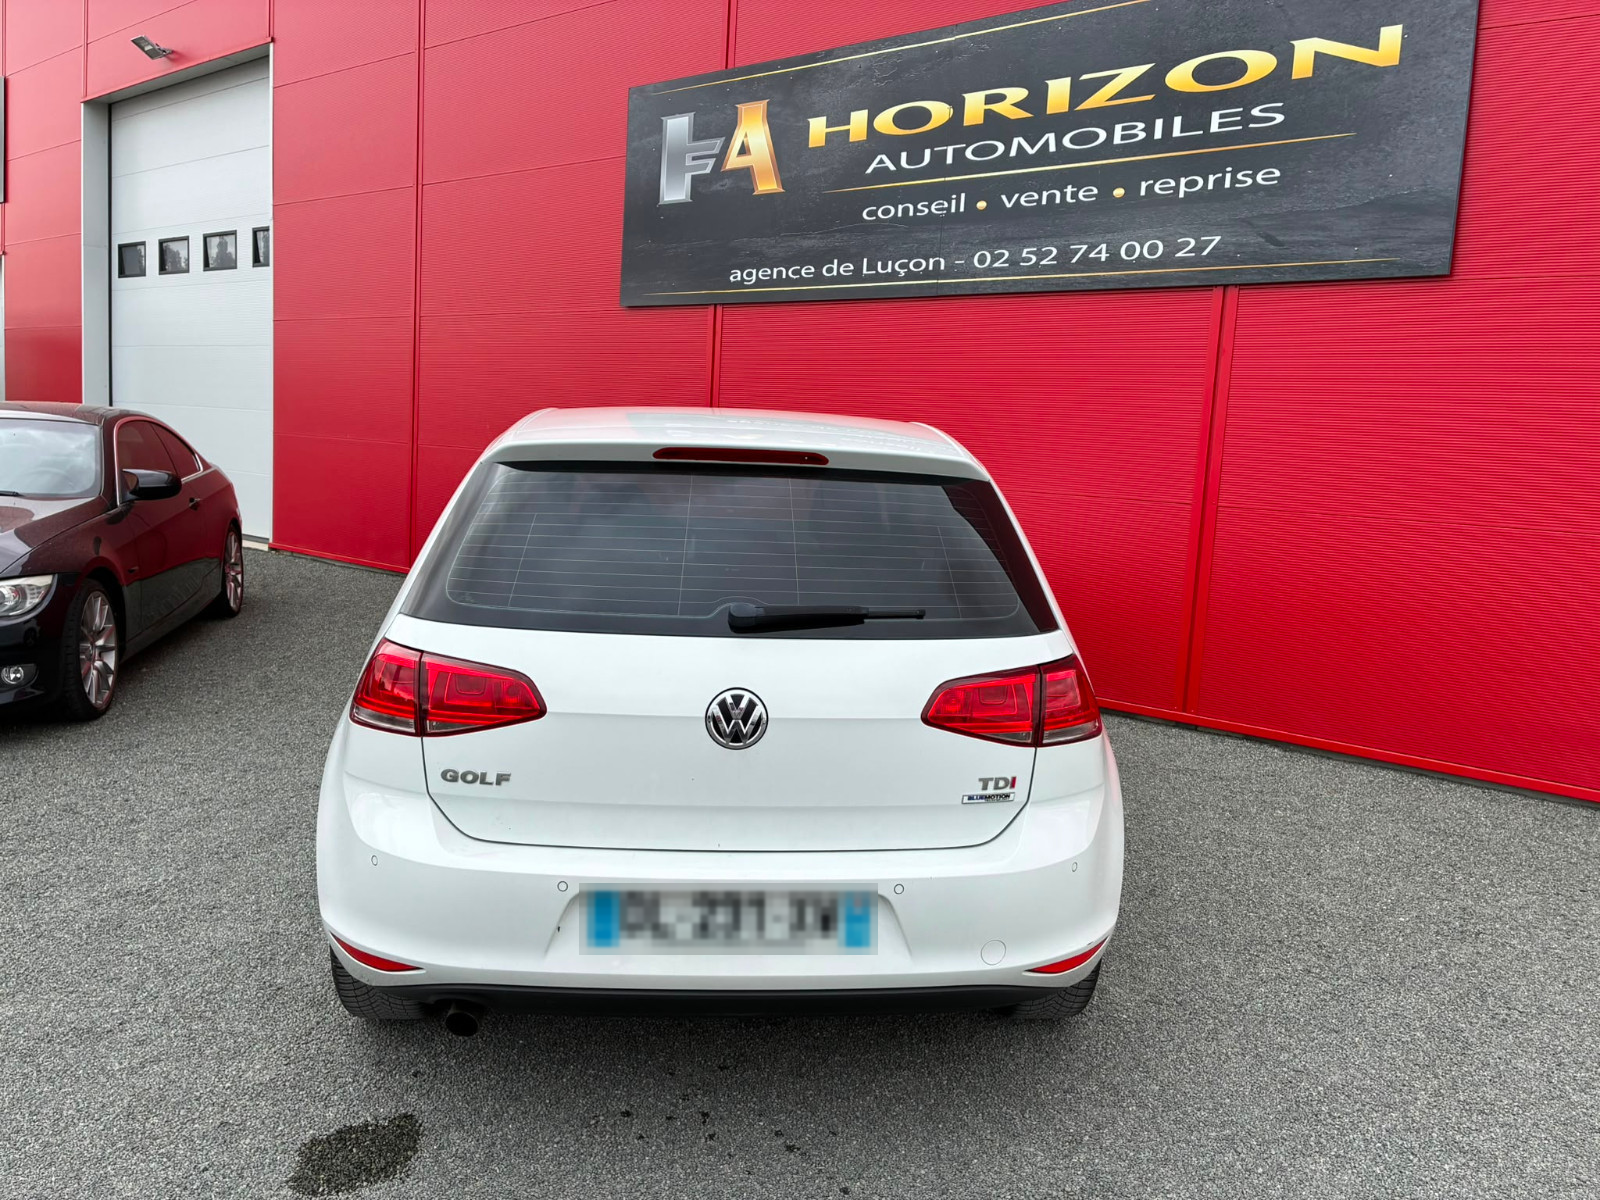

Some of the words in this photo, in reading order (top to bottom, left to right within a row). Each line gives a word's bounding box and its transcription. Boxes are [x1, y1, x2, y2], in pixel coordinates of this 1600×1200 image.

[807, 24, 1403, 148] HORIZON
[865, 102, 1285, 174] AUTOMOBILES
[861, 193, 965, 221] conseil
[1001, 182, 1099, 208] vente
[1138, 167, 1281, 199] reprise
[729, 264, 814, 285] agence
[822, 258, 855, 277] de
[863, 255, 946, 277] Luçon
[973, 250, 1010, 269] 02
[1020, 246, 1058, 266] 52
[1070, 244, 1110, 263] 74
[1119, 240, 1164, 260] 00
[1174, 235, 1222, 257] 27
[440, 768, 512, 786] GOLF
[978, 776, 1017, 791] TDI
